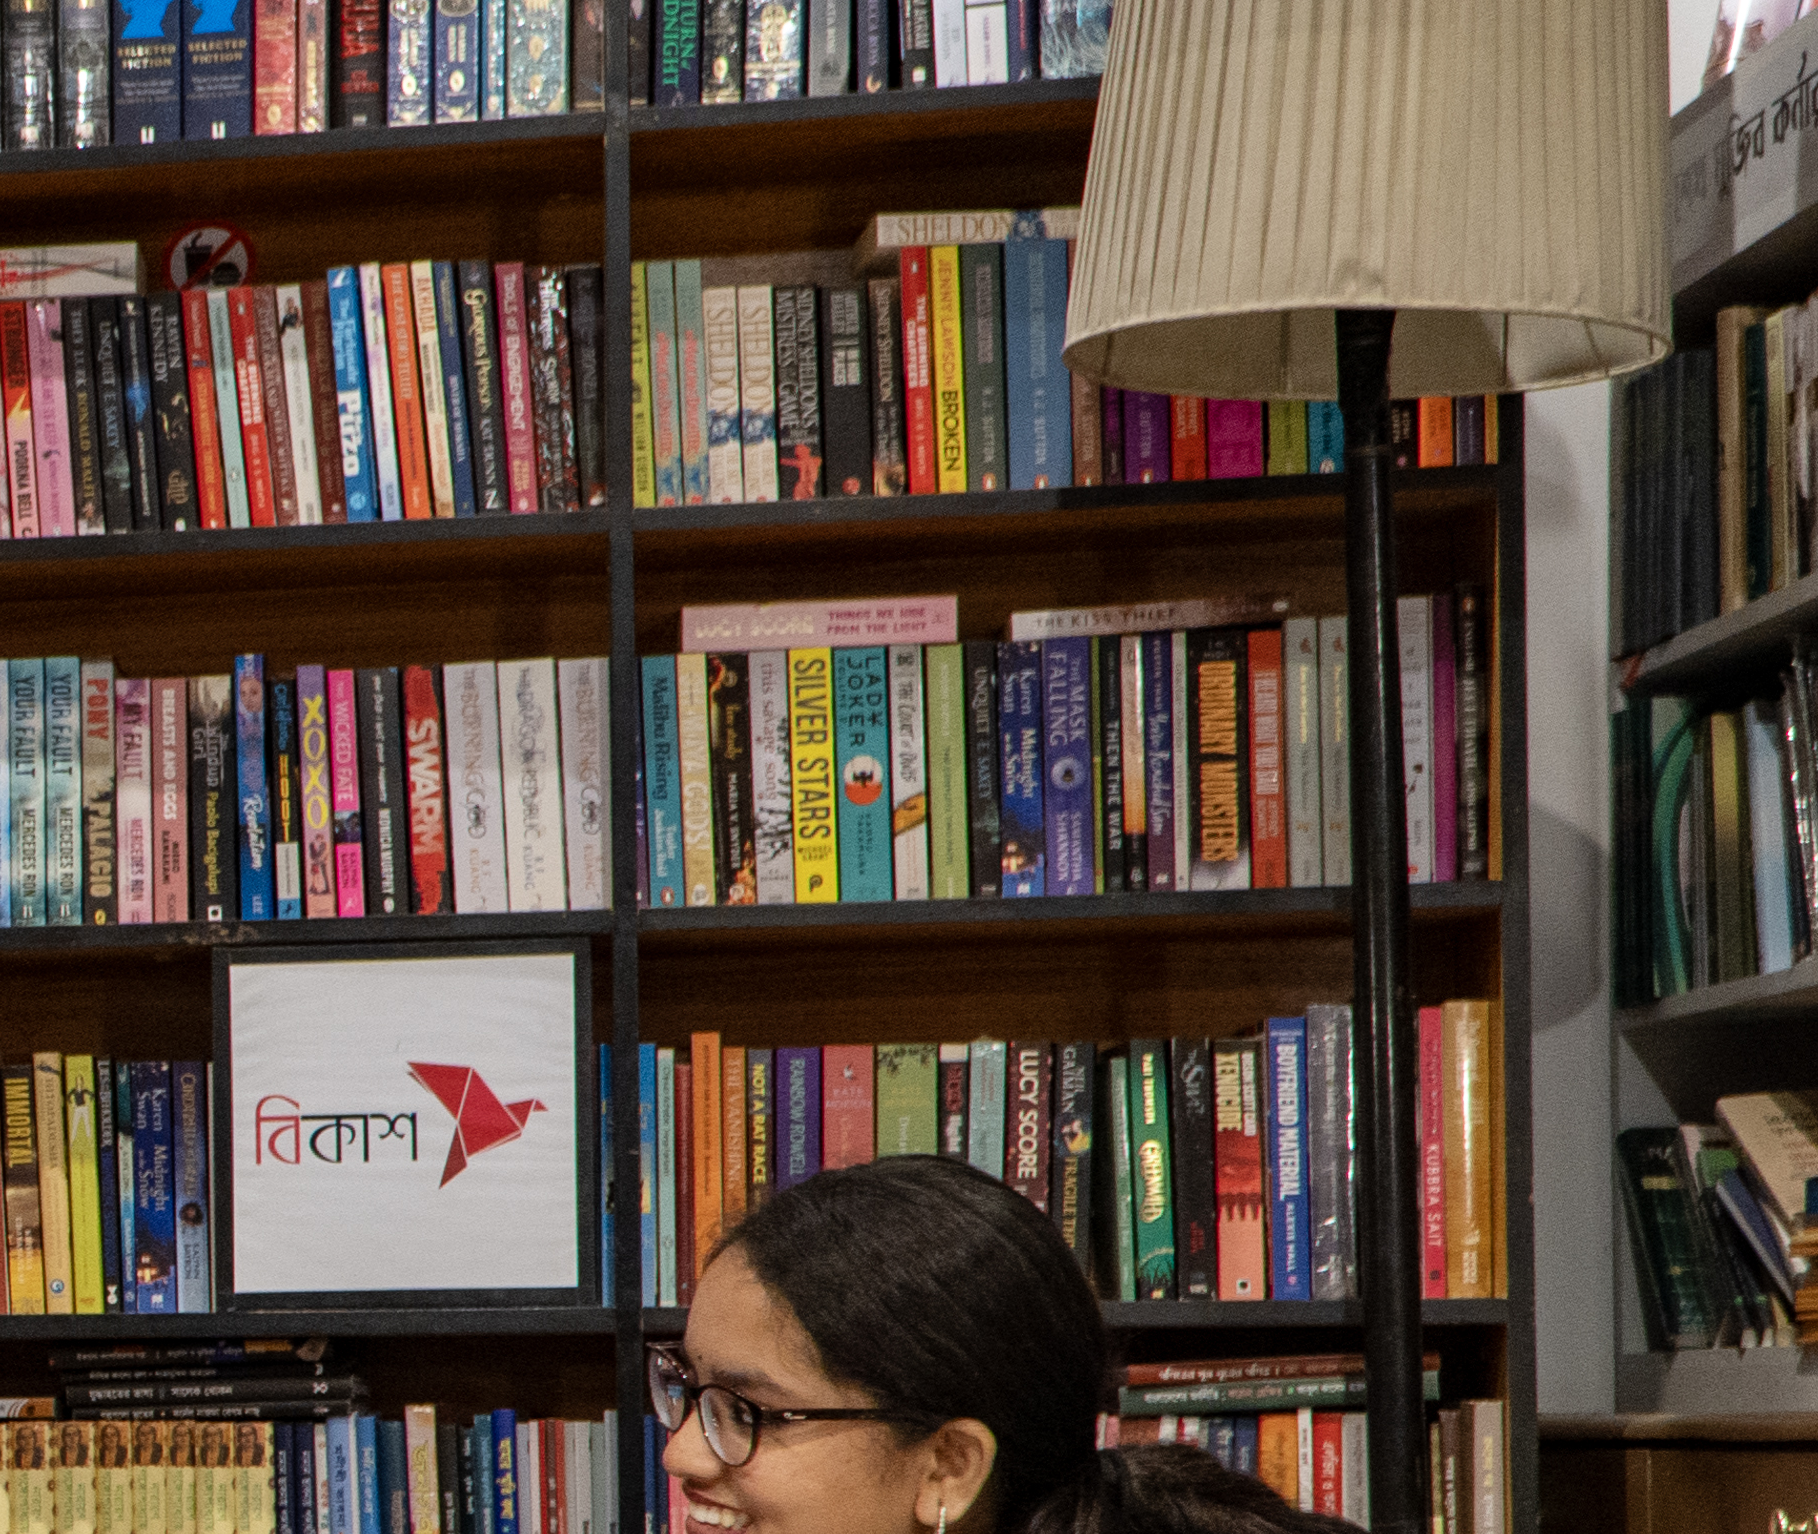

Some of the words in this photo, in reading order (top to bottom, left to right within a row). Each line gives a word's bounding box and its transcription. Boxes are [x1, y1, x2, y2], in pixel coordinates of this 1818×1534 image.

[943, 390, 959, 472] BROKEN
[51, 673, 73, 719] YOUR
[793, 659, 831, 747] SILVER
[847, 656, 866, 747] JOKER
[1198, 660, 1238, 756] ORDINARY
[51, 723, 73, 777] FAULT
[408, 717, 442, 857] SWARM
[796, 757, 832, 840] STARS
[1200, 761, 1239, 863] MONSTERS
[59, 807, 74, 869] MERCEDES
[59, 872, 74, 896] RON
[1017, 1051, 1039, 1104] LUCY
[1215, 1053, 1241, 1132] XENOCIDE
[1275, 1043, 1300, 1127] BOYFRIEND
[256, 1094, 418, 1167] বিকাশ
[1018, 1109, 1040, 1179] SCORE
[1277, 1128, 1301, 1200] MATERIAL
[1426, 1144, 1441, 1205] KUBBRA
[1428, 1213, 1442, 1249] SAIT
